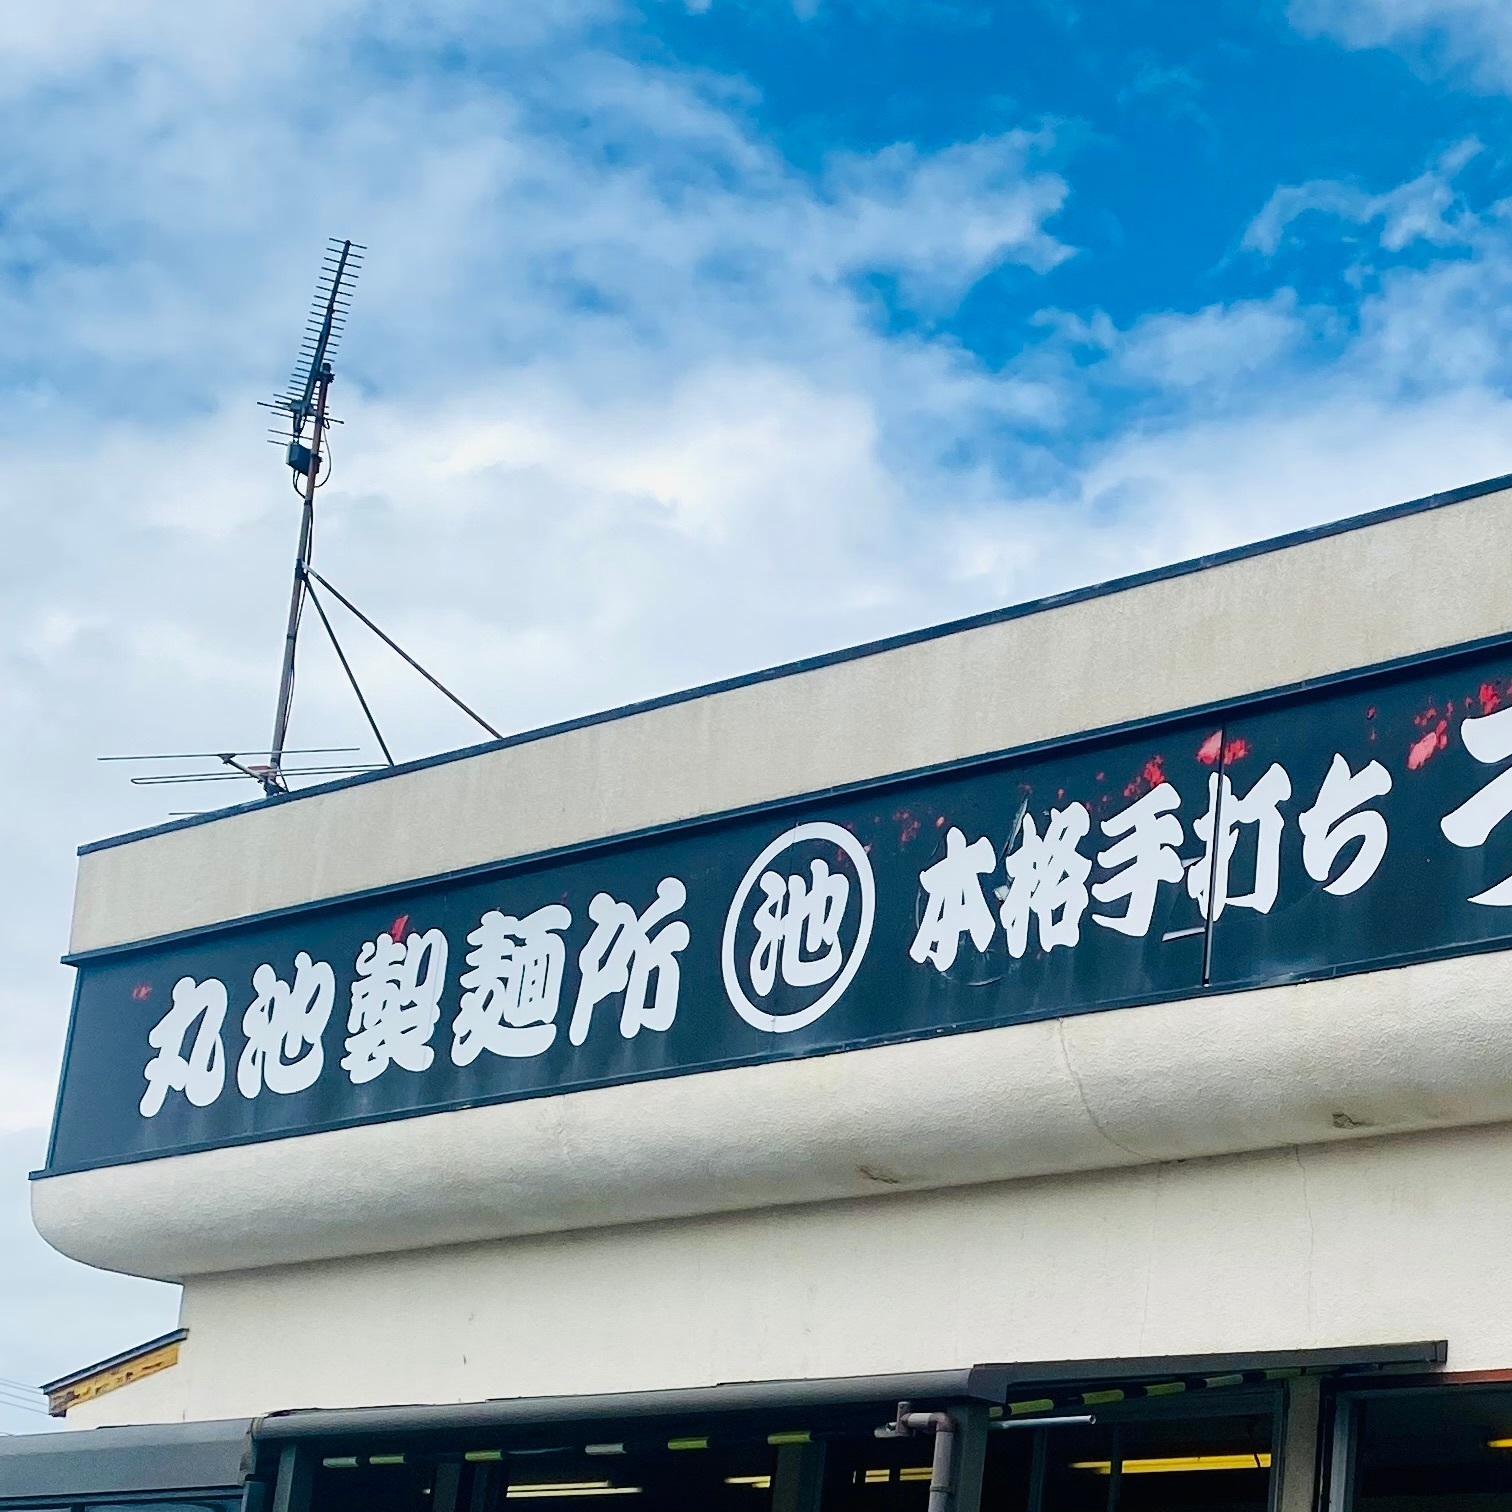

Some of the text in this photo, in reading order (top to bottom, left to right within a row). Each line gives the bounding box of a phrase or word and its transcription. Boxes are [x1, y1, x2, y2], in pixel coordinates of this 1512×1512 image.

[138, 876, 691, 1119] 丸池製麺所
[908, 751, 1394, 973] 本格手打ち
